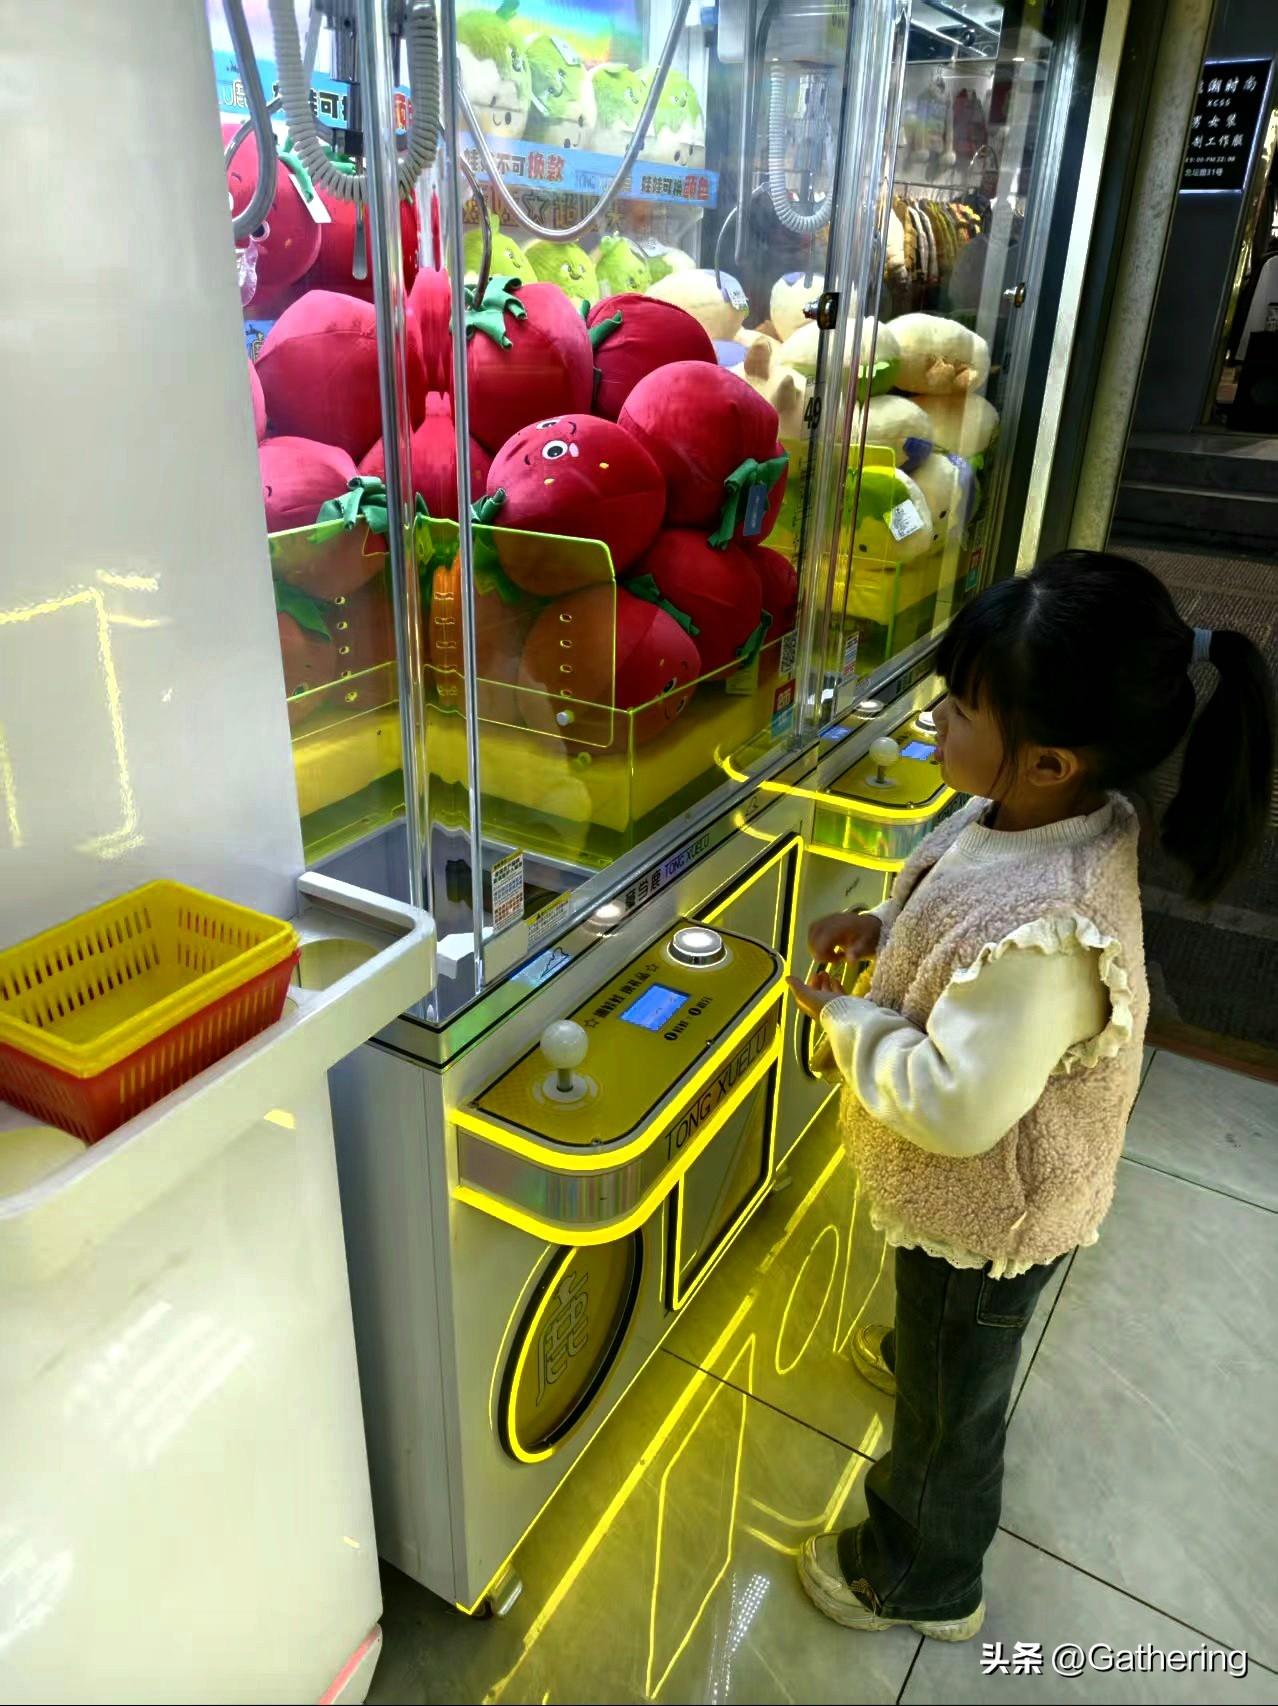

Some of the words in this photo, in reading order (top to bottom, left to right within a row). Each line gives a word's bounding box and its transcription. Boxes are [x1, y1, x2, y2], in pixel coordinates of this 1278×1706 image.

[1190, 134, 1244, 149] 制工作服
[665, 1092, 713, 1161] TONG
[717, 1020, 769, 1104] XUELU
